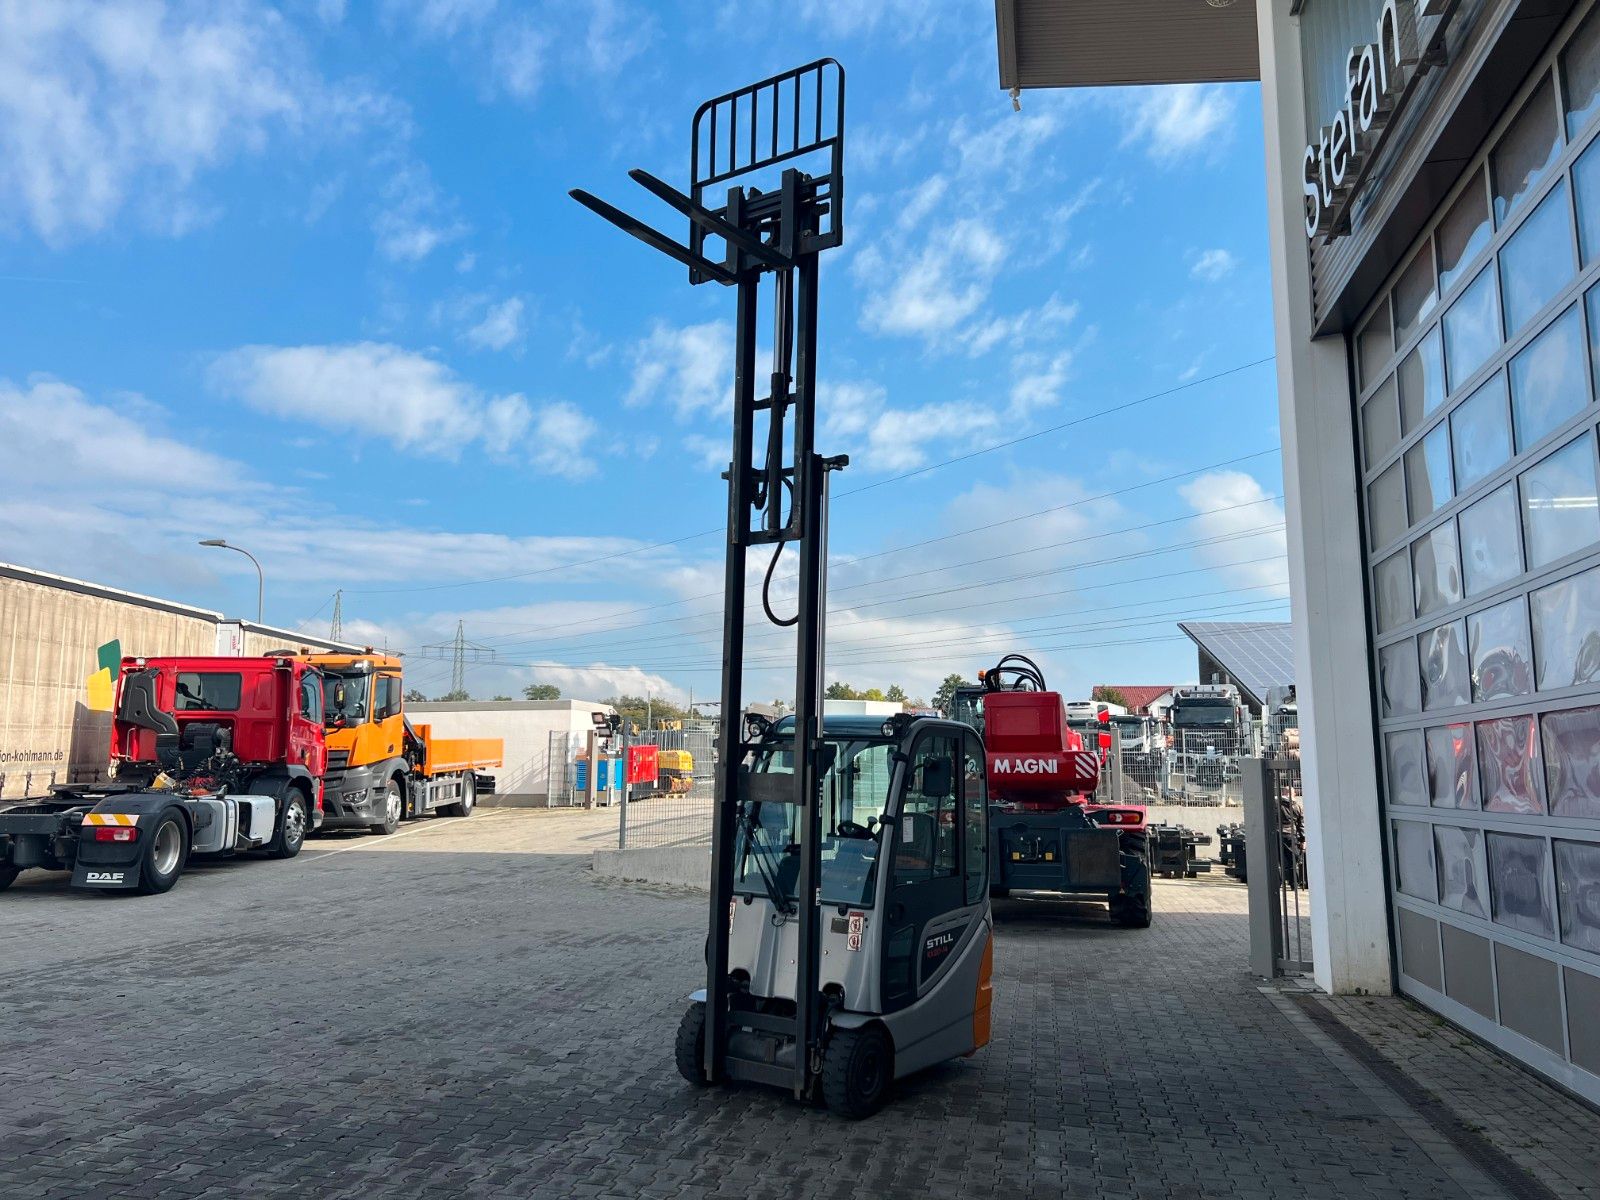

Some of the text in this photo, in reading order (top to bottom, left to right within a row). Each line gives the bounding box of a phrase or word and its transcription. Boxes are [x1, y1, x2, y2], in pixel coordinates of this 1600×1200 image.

[1302, 0, 1401, 239] Stefan
[994, 758, 1058, 774] MAGNI
[86, 872, 124, 880] DAF
[926, 933, 954, 949] STILL
